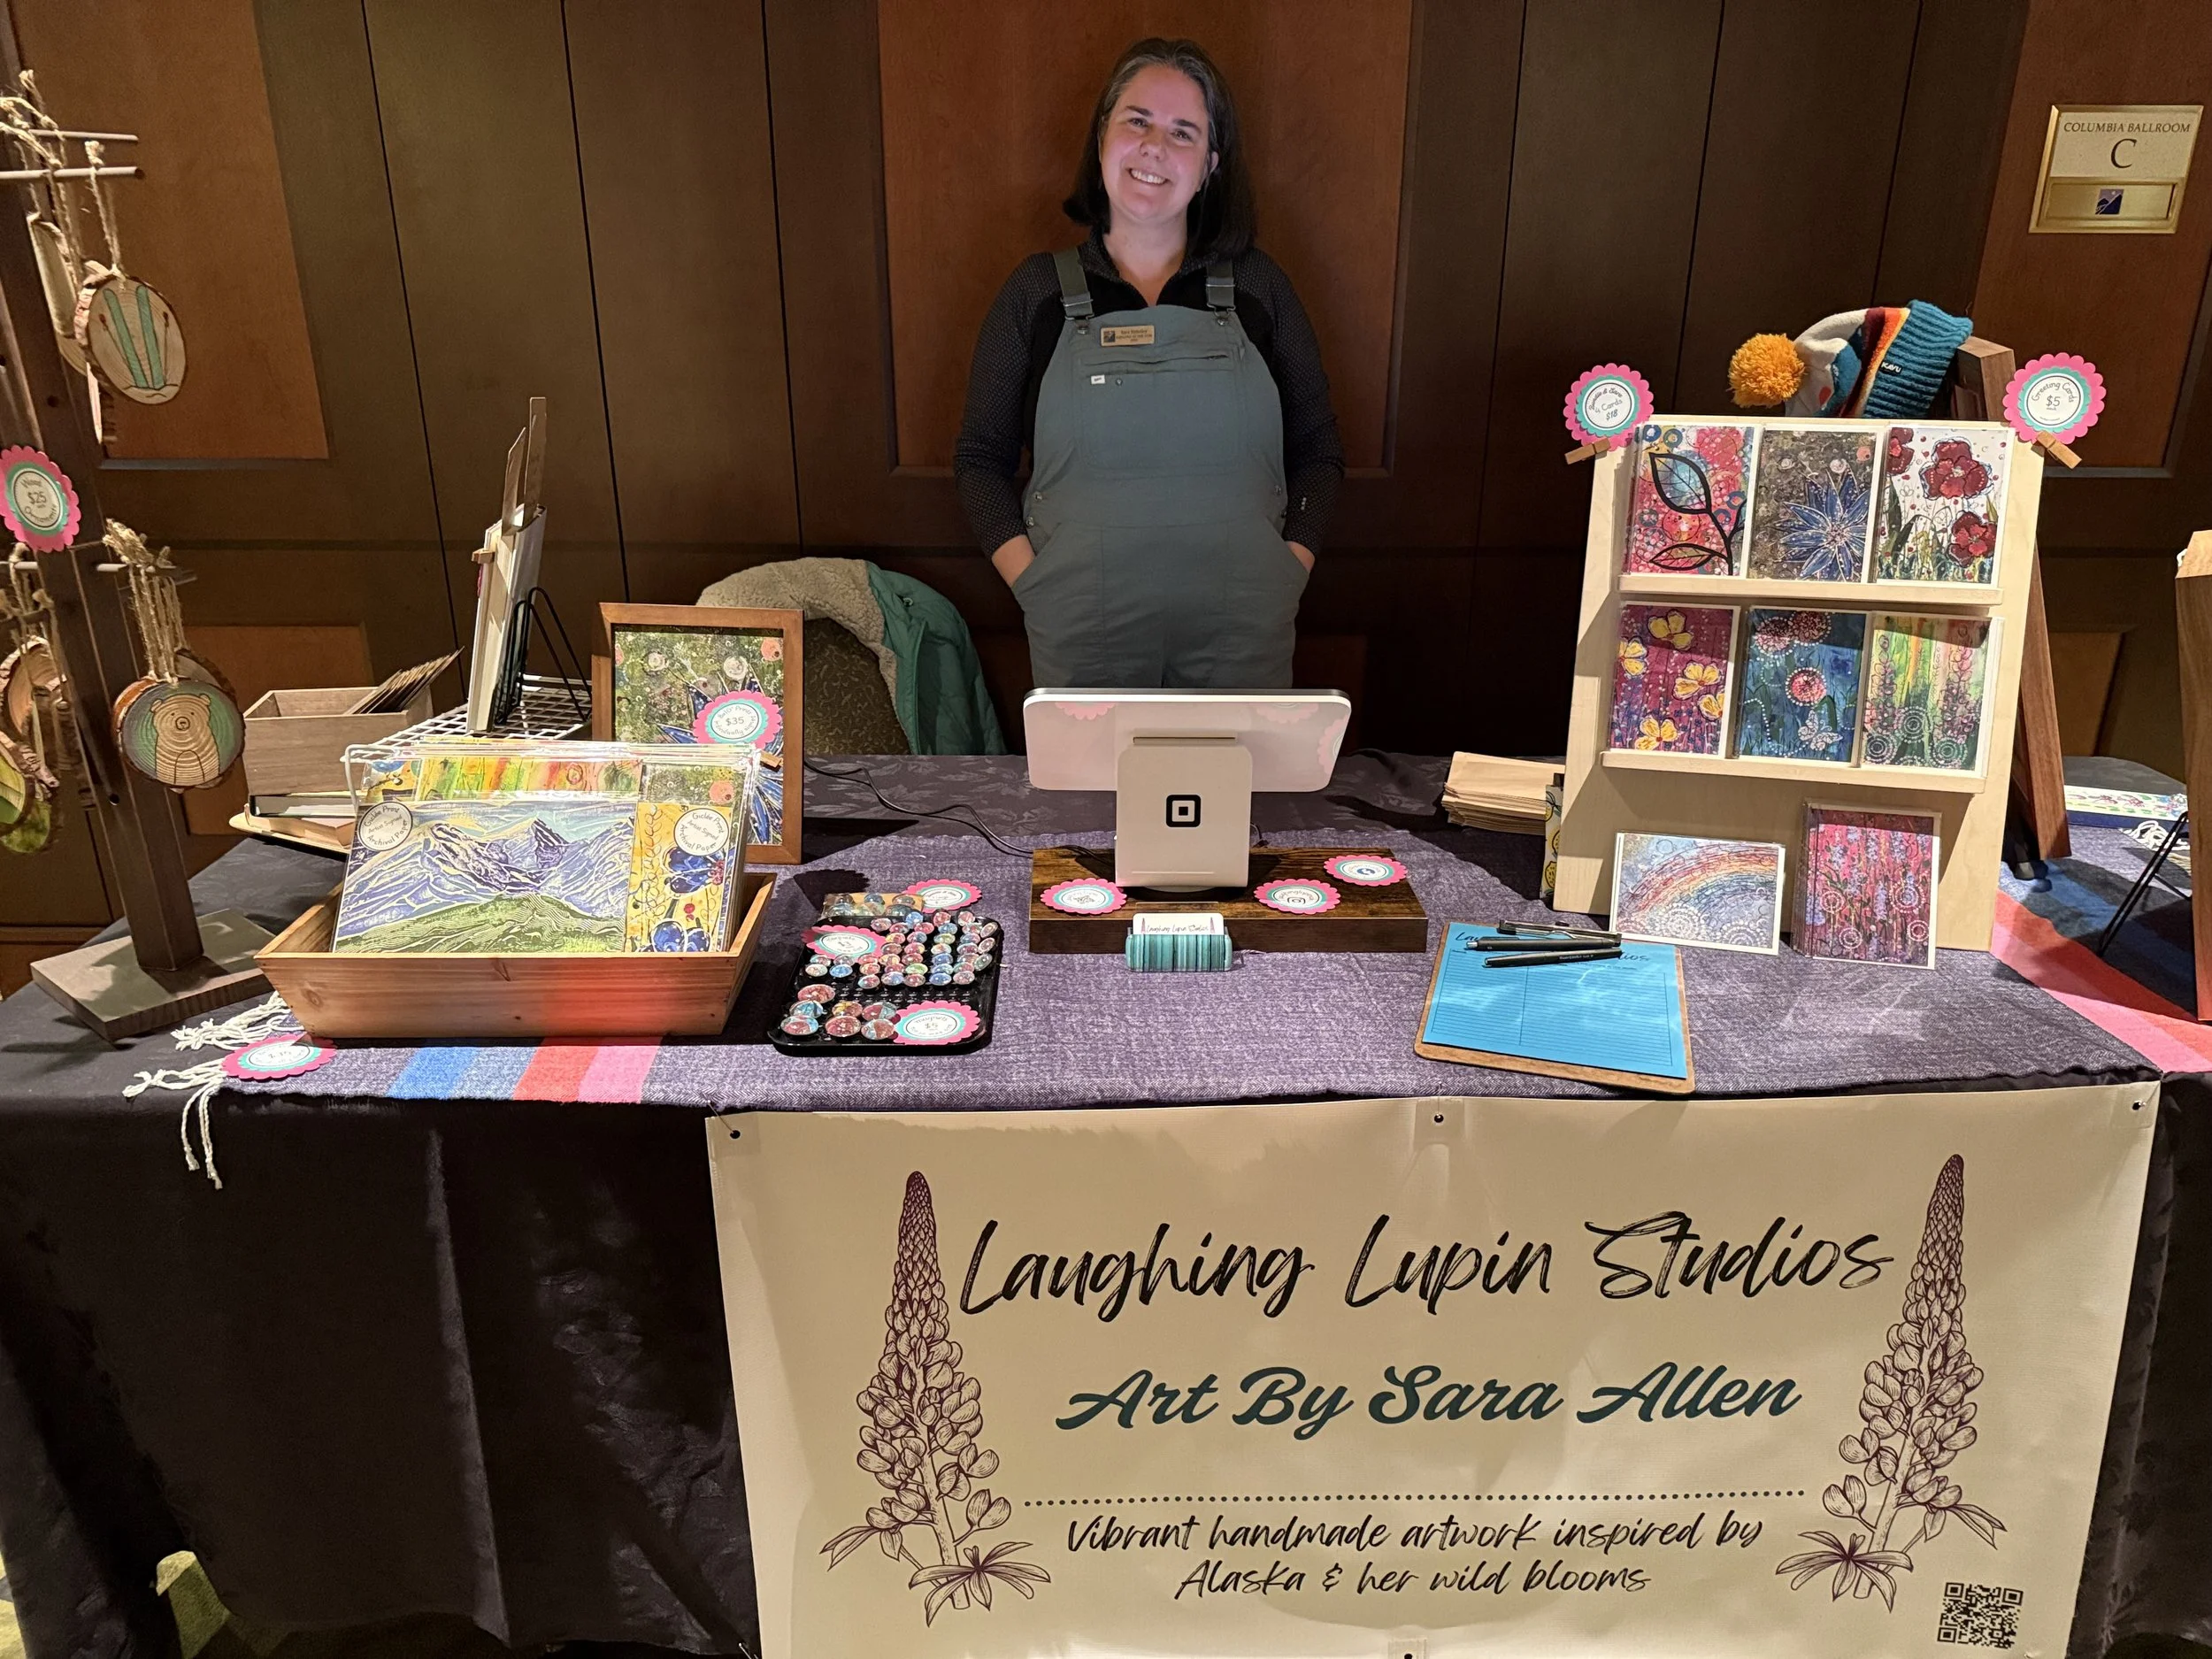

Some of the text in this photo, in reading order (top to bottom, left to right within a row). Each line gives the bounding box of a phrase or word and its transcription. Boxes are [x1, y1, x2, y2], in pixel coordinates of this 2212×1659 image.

[2063, 122, 2191, 133] COLUMBIA BALLROOM
[2110, 138, 2137, 169] C
[1881, 361, 1901, 373] KAVU
[2031, 382, 2078, 403] Greeting Cards
[2046, 395, 2060, 407] $5
[1601, 398, 1623, 411] Cards
[1606, 409, 1618, 421] $18
[27, 491, 47, 504] $25
[726, 717, 744, 726] $35
[367, 819, 409, 846] Archival Paper
[713, 818, 725, 833] Print
[680, 824, 717, 852] Archival Paper
[959, 1210, 1894, 1323] Laughing Lupin Studios
[1055, 1362, 1802, 1440] Art By Sara Allen
[1068, 1509, 1763, 1555] Vibrant handmade artwork inspired by
[1174, 1559, 1651, 1601] Alaska & her wild blooms
